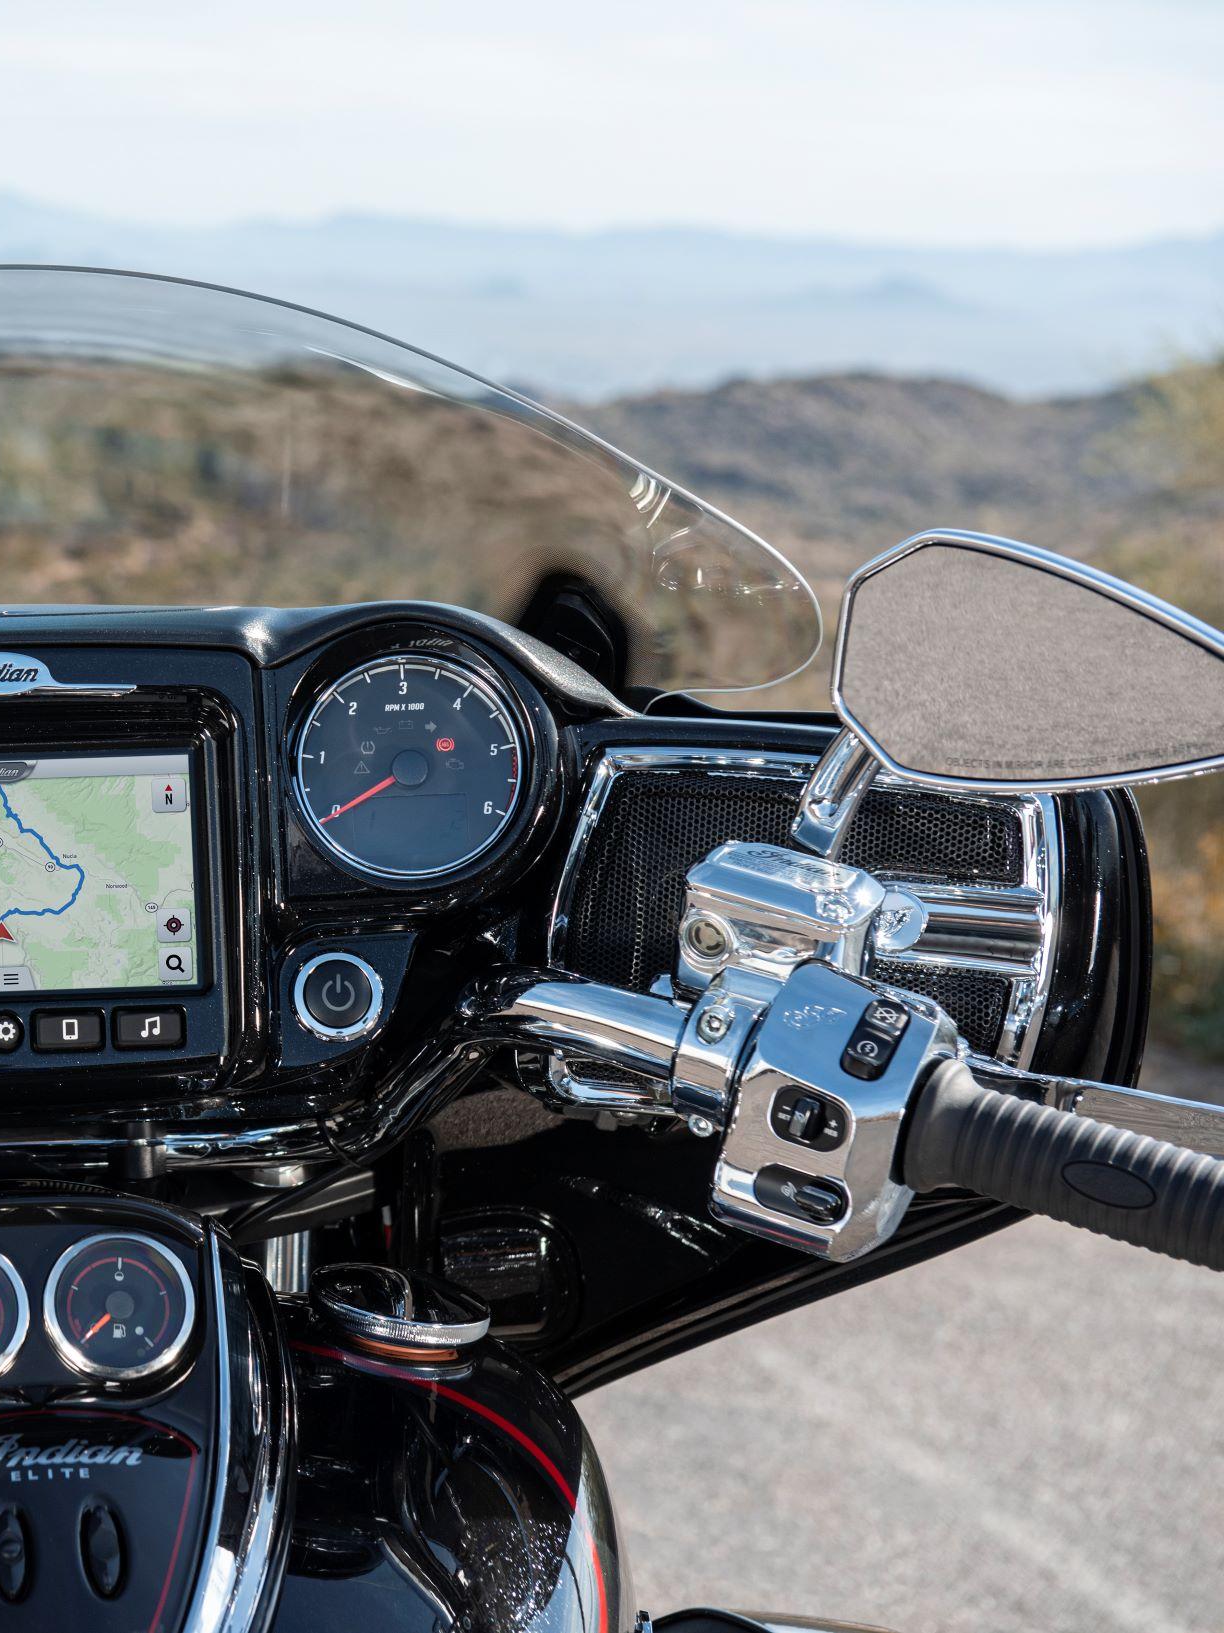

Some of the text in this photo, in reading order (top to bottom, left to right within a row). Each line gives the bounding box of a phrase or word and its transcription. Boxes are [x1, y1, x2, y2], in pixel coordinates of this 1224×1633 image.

[398, 682, 408, 695] 3
[348, 702, 358, 715] 2
[384, 704, 400, 712] RPM
[407, 703, 425, 711] 1000
[452, 697, 462, 711] 4
[489, 744, 498, 756] 5
[319, 751, 325, 764] 1
[945, 757, 990, 769] OBJECTS
[165, 793, 173, 805] N
[483, 802, 493, 815] 6
[11, 1467, 90, 1482] ELITE
